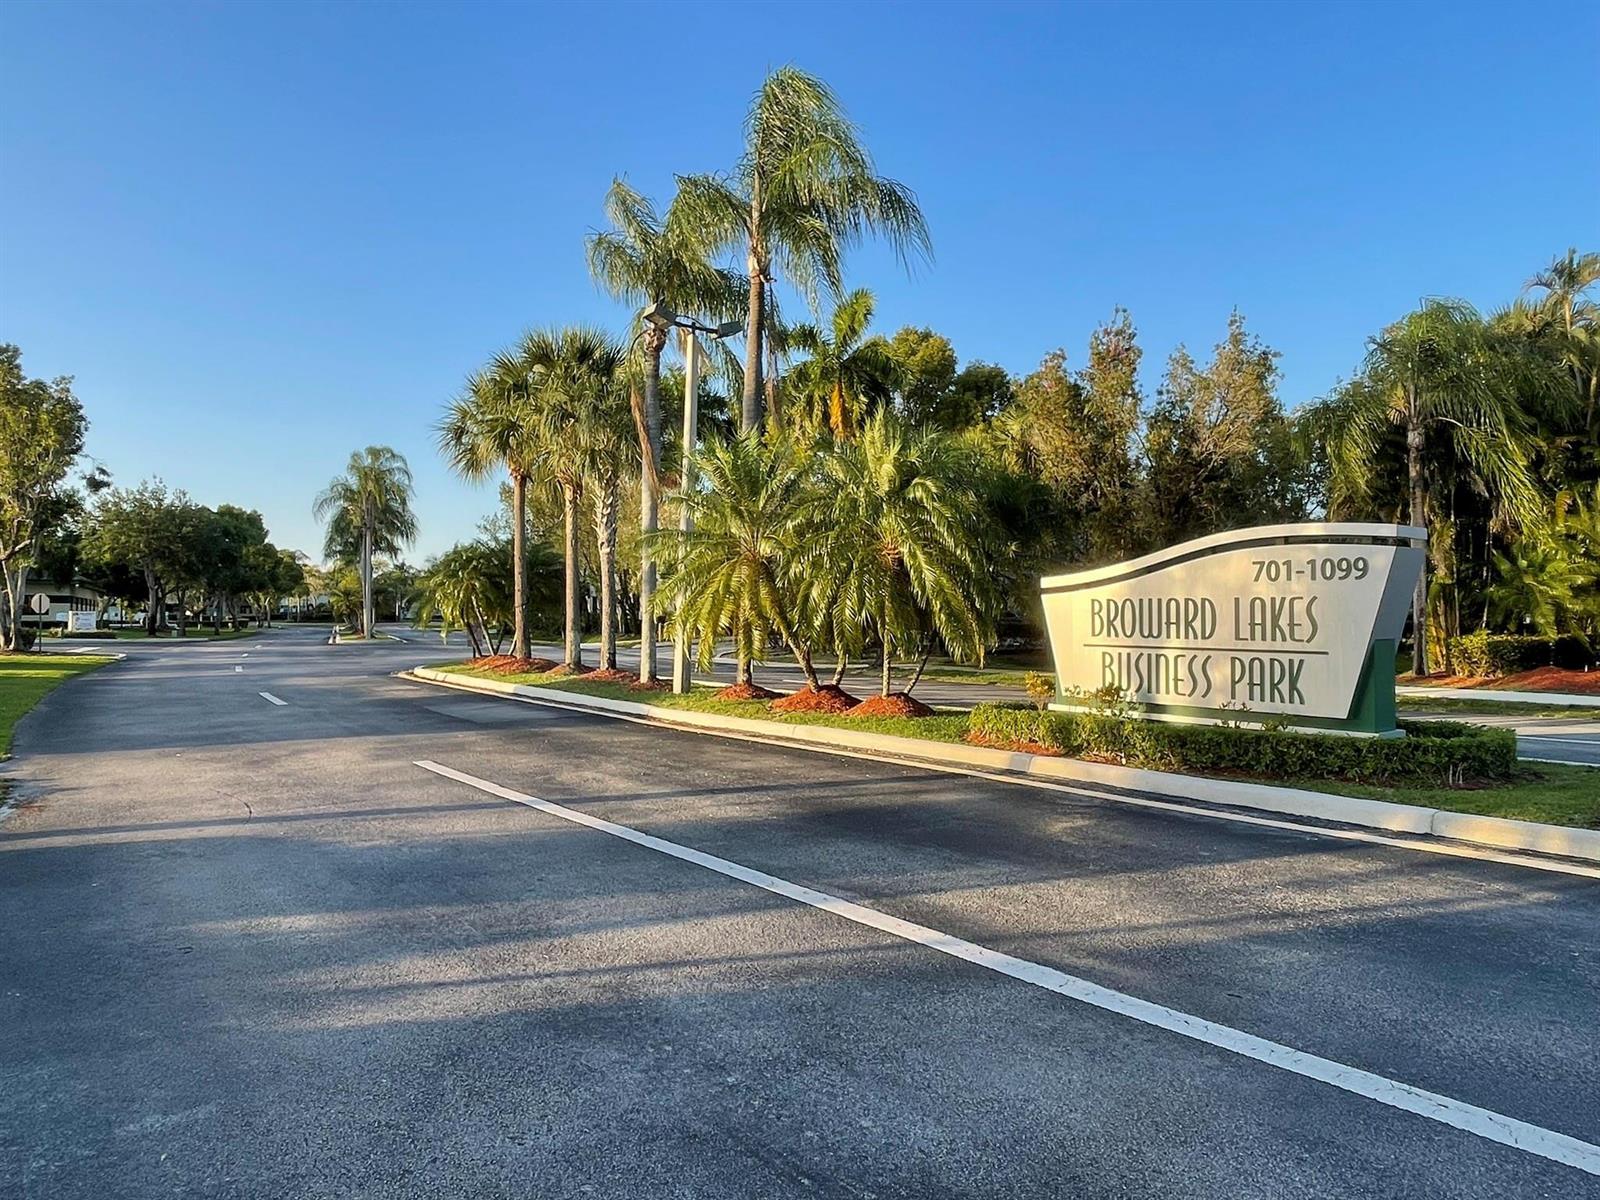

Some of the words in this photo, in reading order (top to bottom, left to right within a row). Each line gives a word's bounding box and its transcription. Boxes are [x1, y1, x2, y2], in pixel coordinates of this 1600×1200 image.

[1252, 557, 1369, 583] 701-1099
[1090, 597, 1217, 641] BROWARD
[1234, 595, 1318, 644] LAKES
[1101, 651, 1212, 699] BUSINESS
[1230, 656, 1305, 705] PARK
